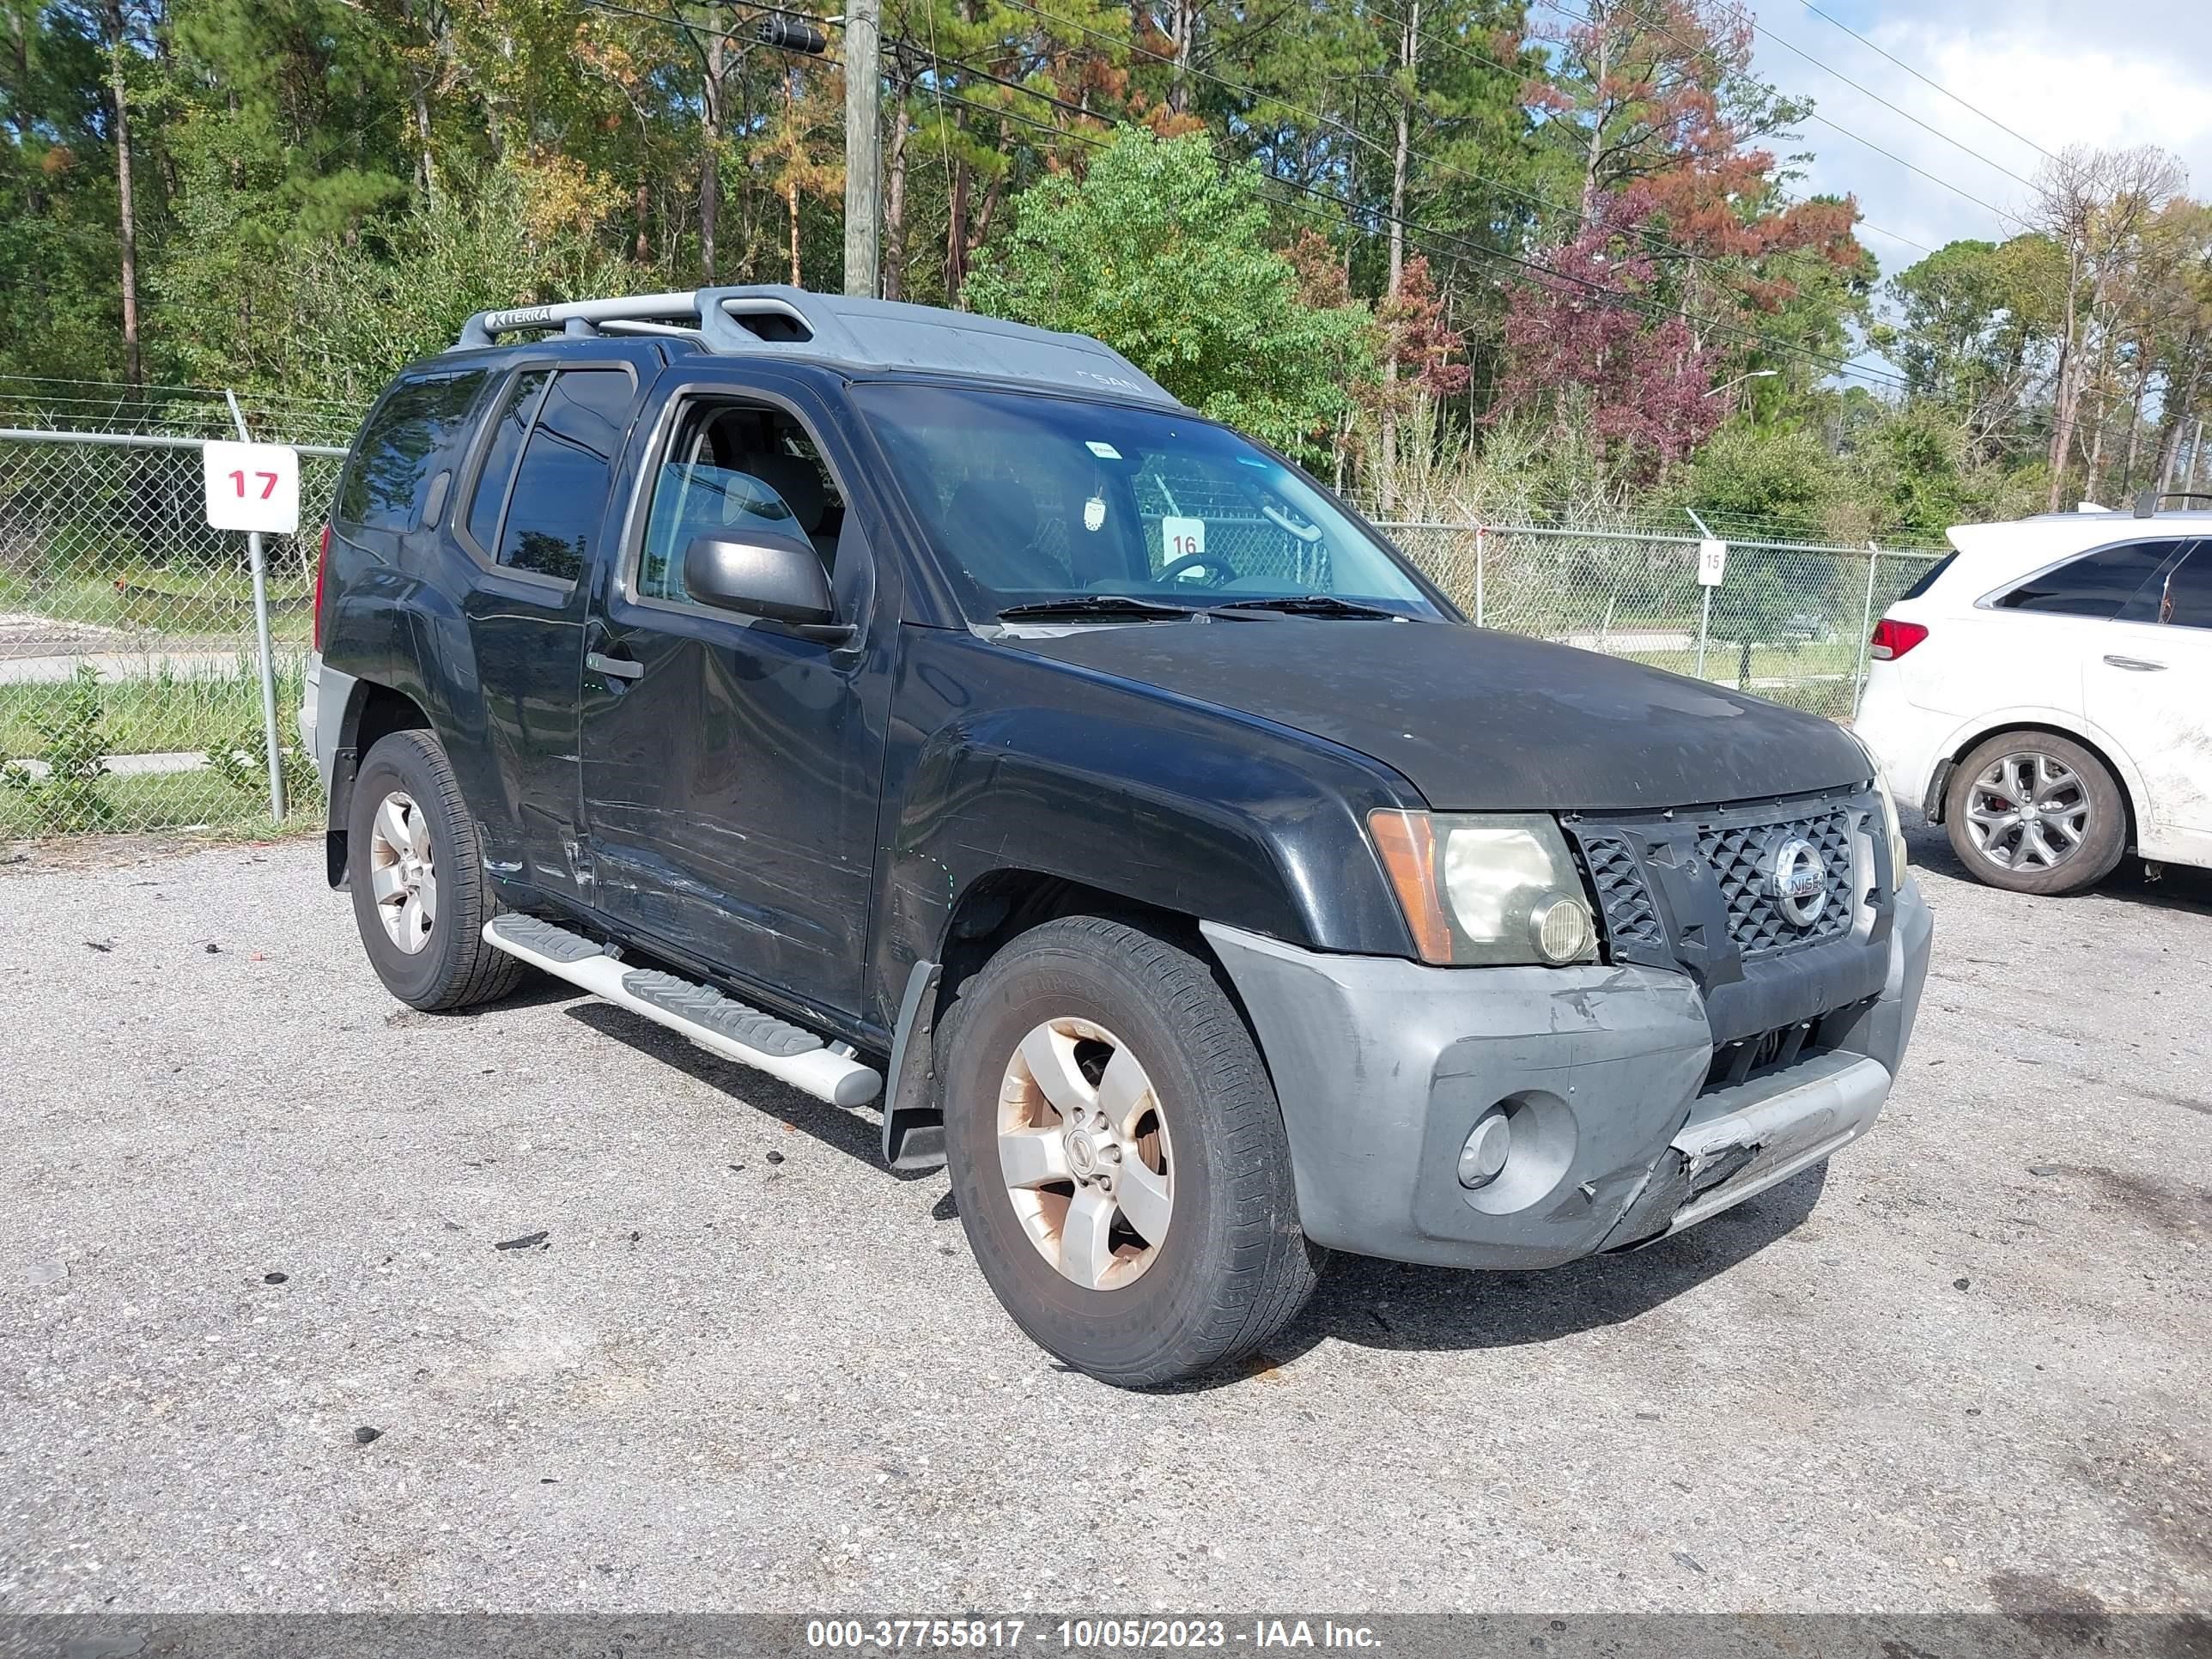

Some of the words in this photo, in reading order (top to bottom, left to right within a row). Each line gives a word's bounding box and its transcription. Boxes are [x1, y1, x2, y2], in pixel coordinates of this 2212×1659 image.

[493, 309, 550, 327] XTERRA
[228, 470, 278, 500] 17
[1173, 535, 1197, 554] 16
[1706, 554, 1720, 569] 15
[1790, 872, 1826, 894] NISSA
